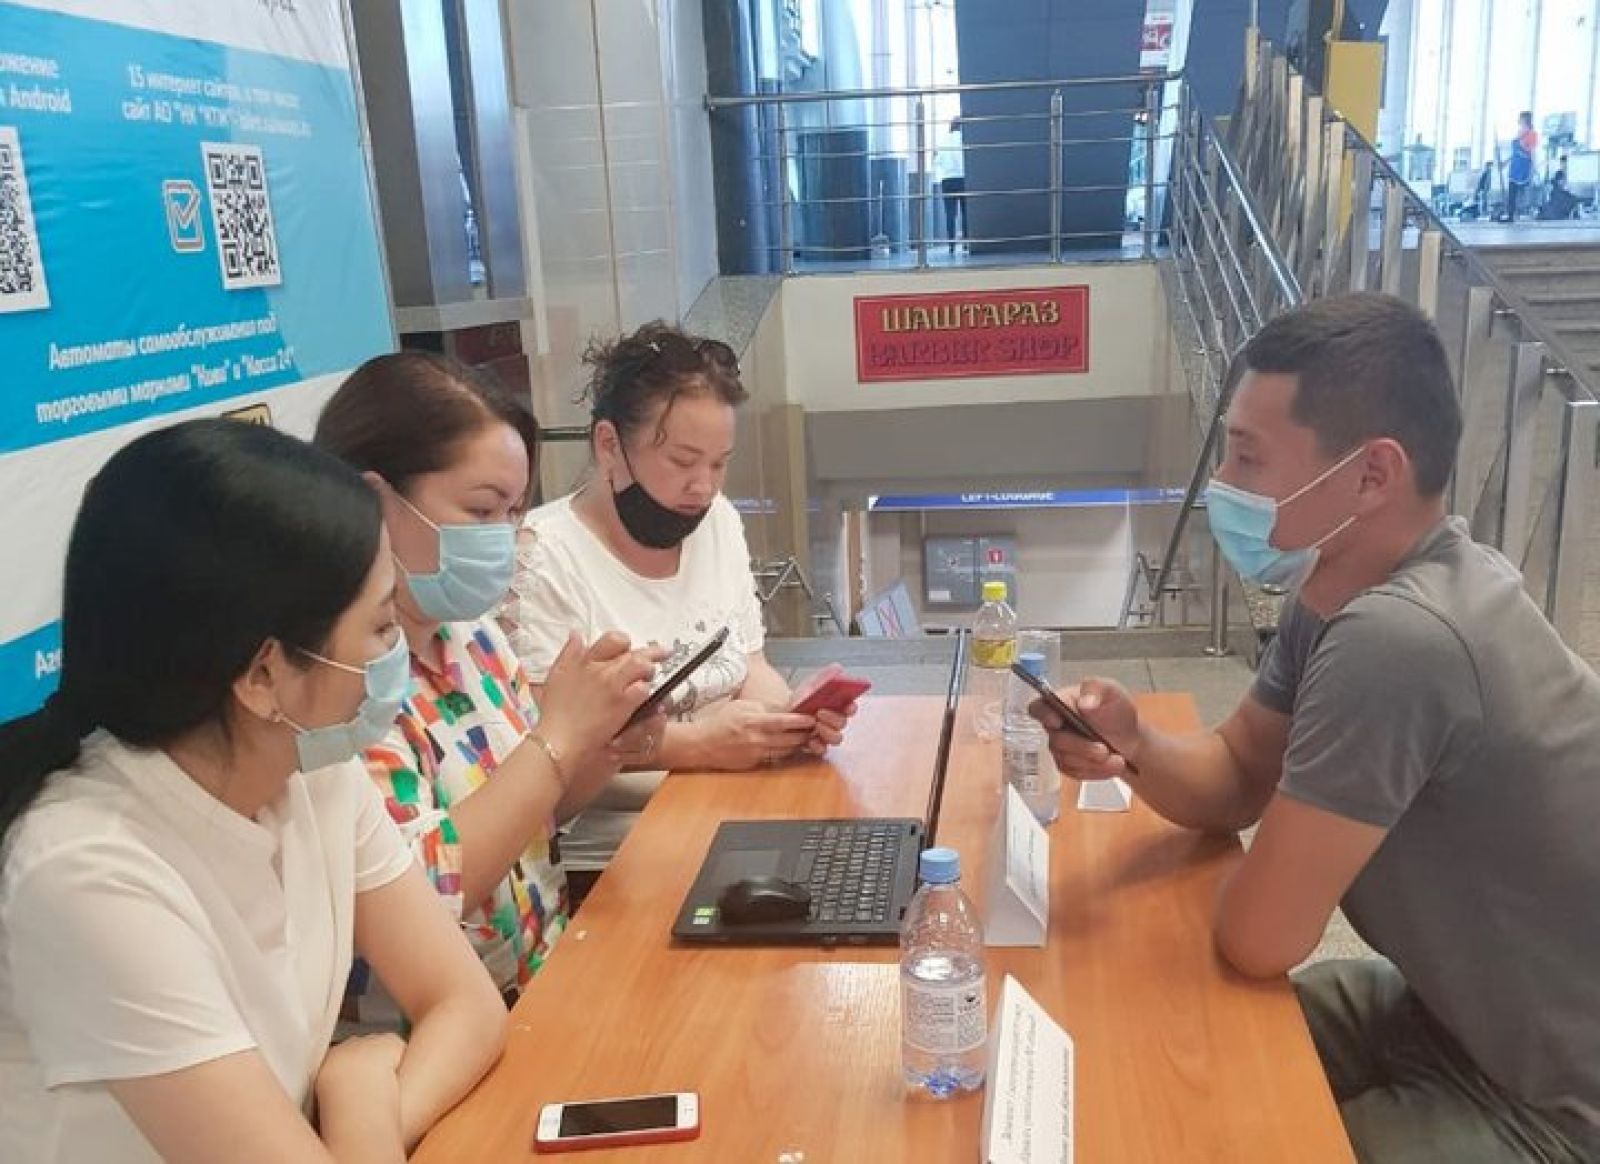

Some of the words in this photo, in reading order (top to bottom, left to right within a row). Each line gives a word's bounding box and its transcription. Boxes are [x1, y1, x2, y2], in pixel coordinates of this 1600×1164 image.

[10, 84, 72, 112] Android
[881, 300, 1060, 332] ШАШТАРАЗ
[49, 342, 136, 370] Автоматы
[997, 335, 1078, 362] SHOP
[36, 387, 128, 423] торговыми
[130, 374, 190, 403] марками
